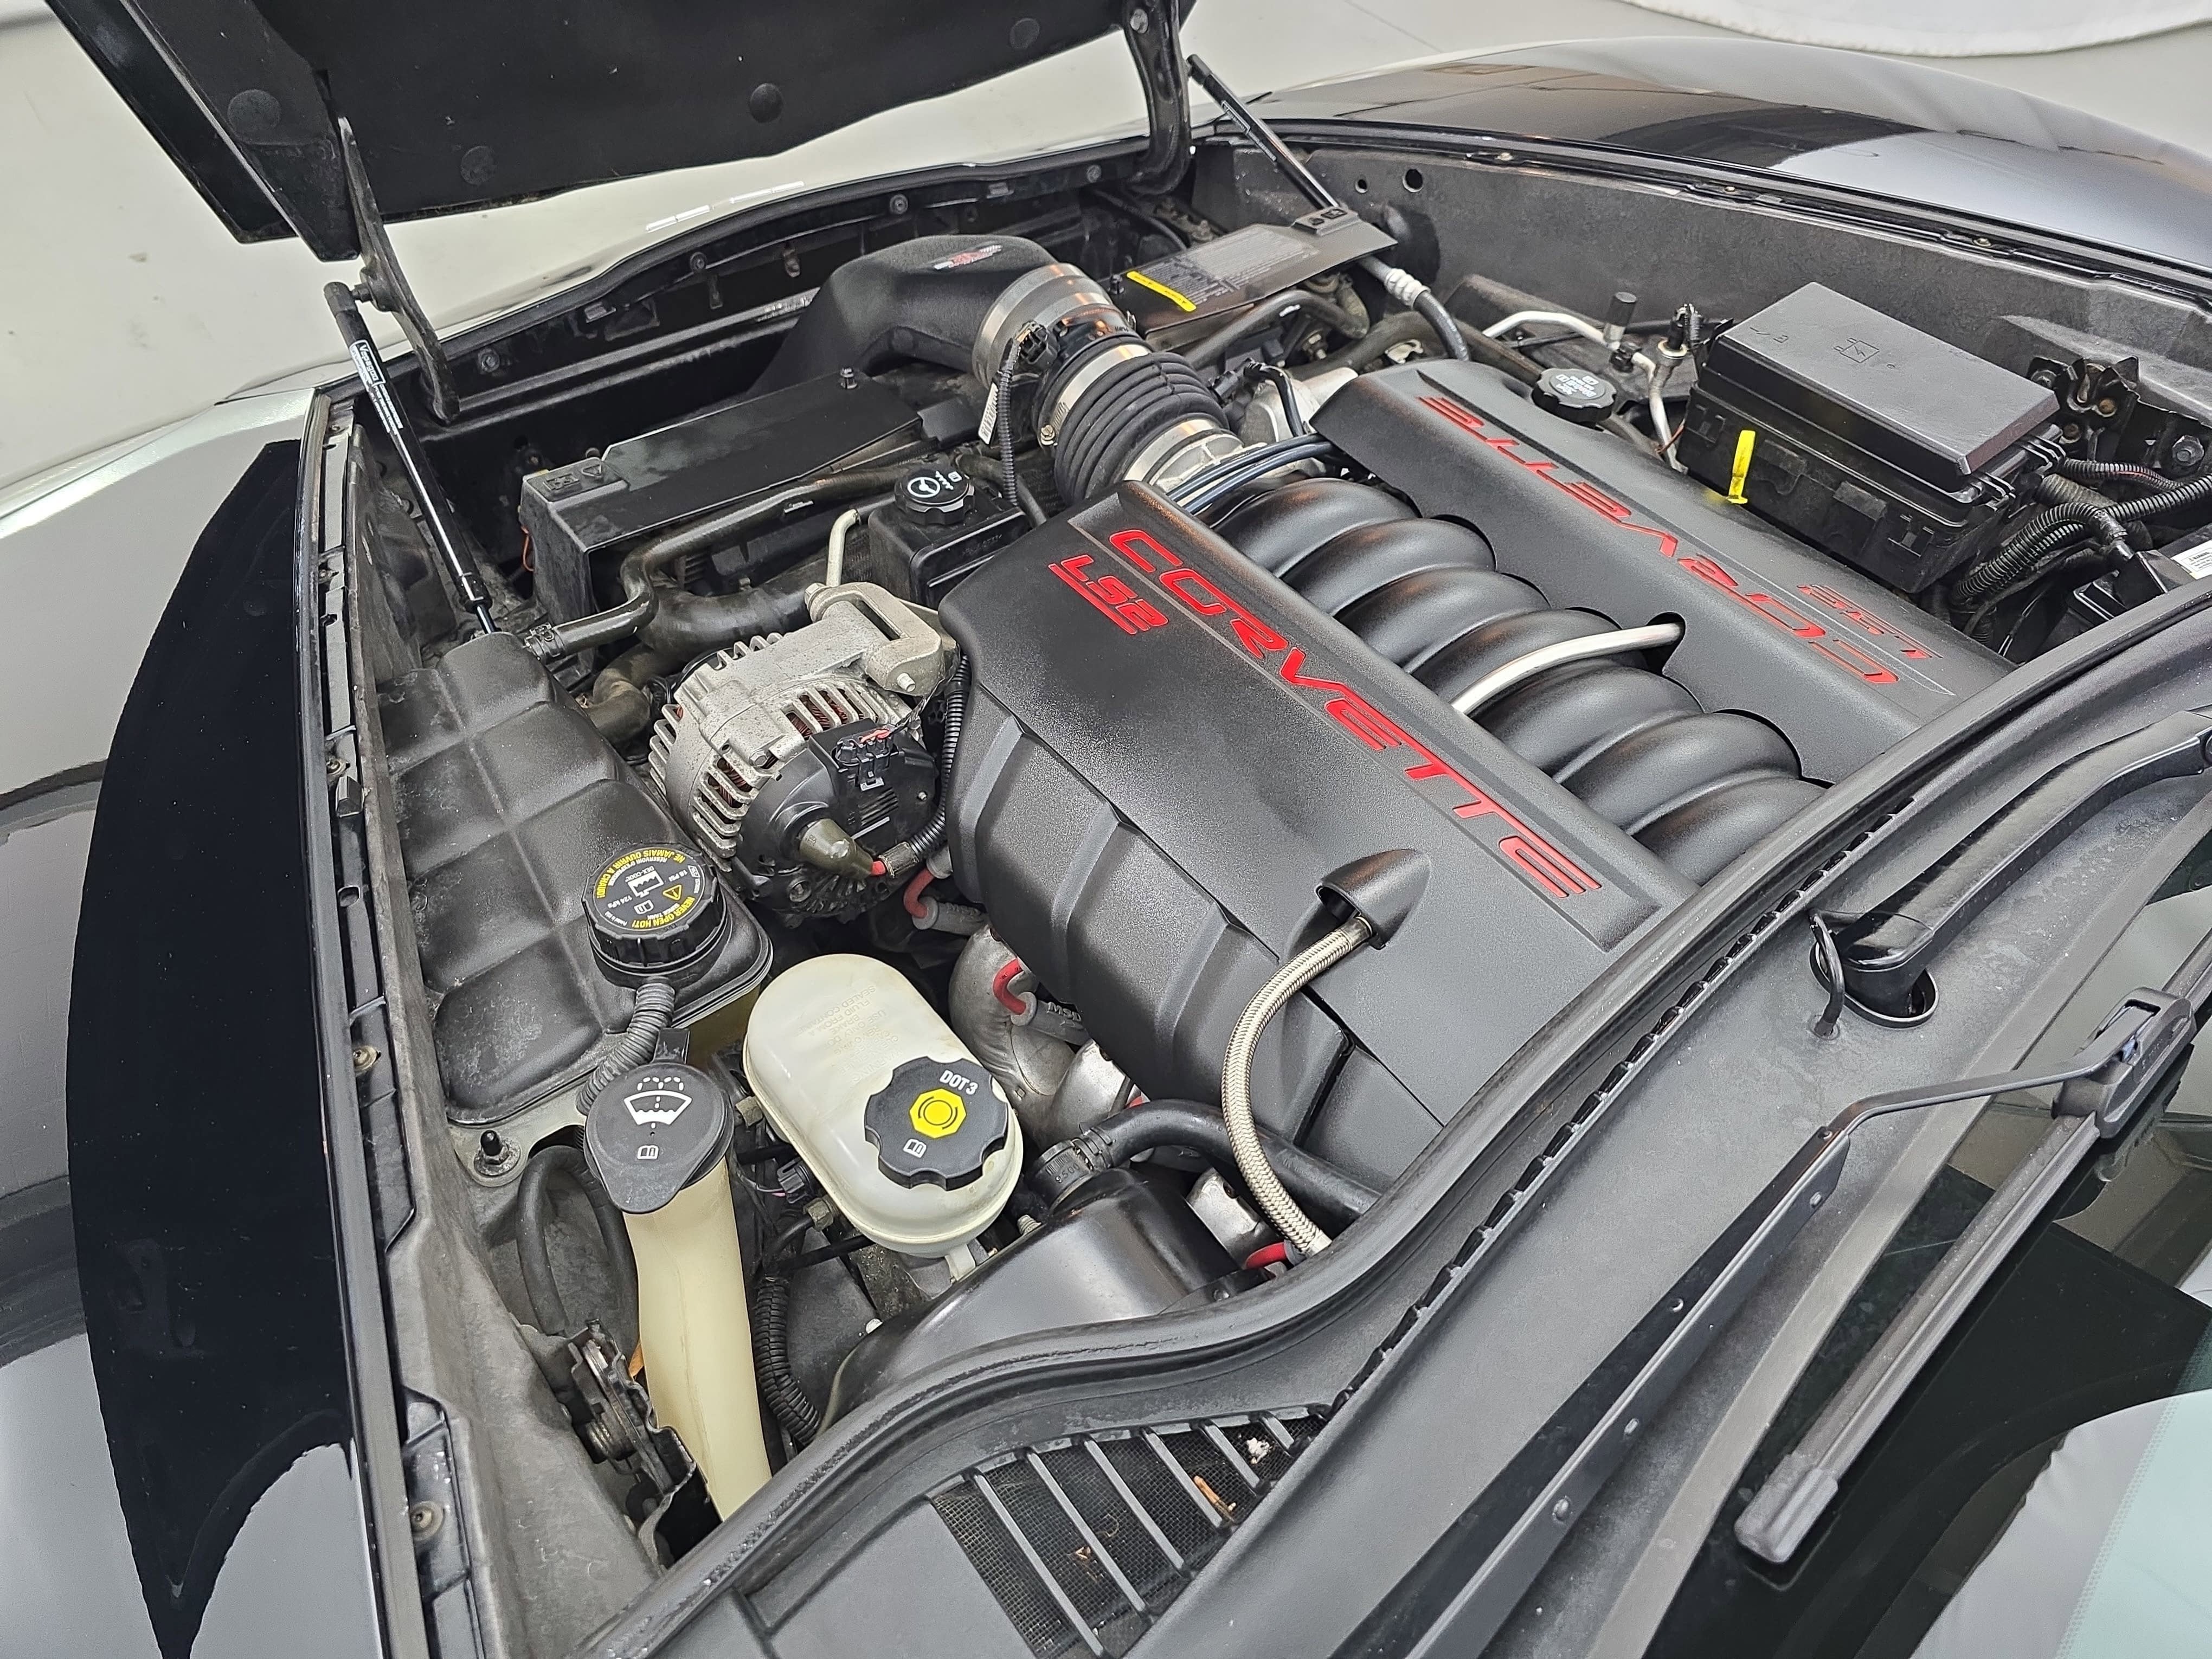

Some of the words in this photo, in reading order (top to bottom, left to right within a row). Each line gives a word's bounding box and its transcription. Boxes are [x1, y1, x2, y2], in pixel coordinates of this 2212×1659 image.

[1417, 396, 1900, 685] CORVETTE
[1052, 554, 1169, 633] LS2
[1797, 583, 1941, 660] LS2
[1109, 528, 1601, 899] CORVETTE
[613, 852, 641, 870] OUVRIR
[643, 850, 675, 858] JAMAIS
[673, 854, 685, 863] NE
[674, 897, 695, 916] NEVER
[632, 919, 651, 928] HOT!
[653, 912, 675, 927] OPEN
[841, 985, 876, 1007] SEALED
[844, 999, 871, 1016] FLUID
[866, 1009, 886, 1024] USE
[1046, 1002, 1081, 1021] MSD
[818, 1014, 844, 1032] FROM
[829, 1014, 860, 1035] BRAKE
[844, 1021, 866, 1038] ONLY
[940, 1070, 970, 1090] DOT
[966, 1082, 979, 1095] 3
